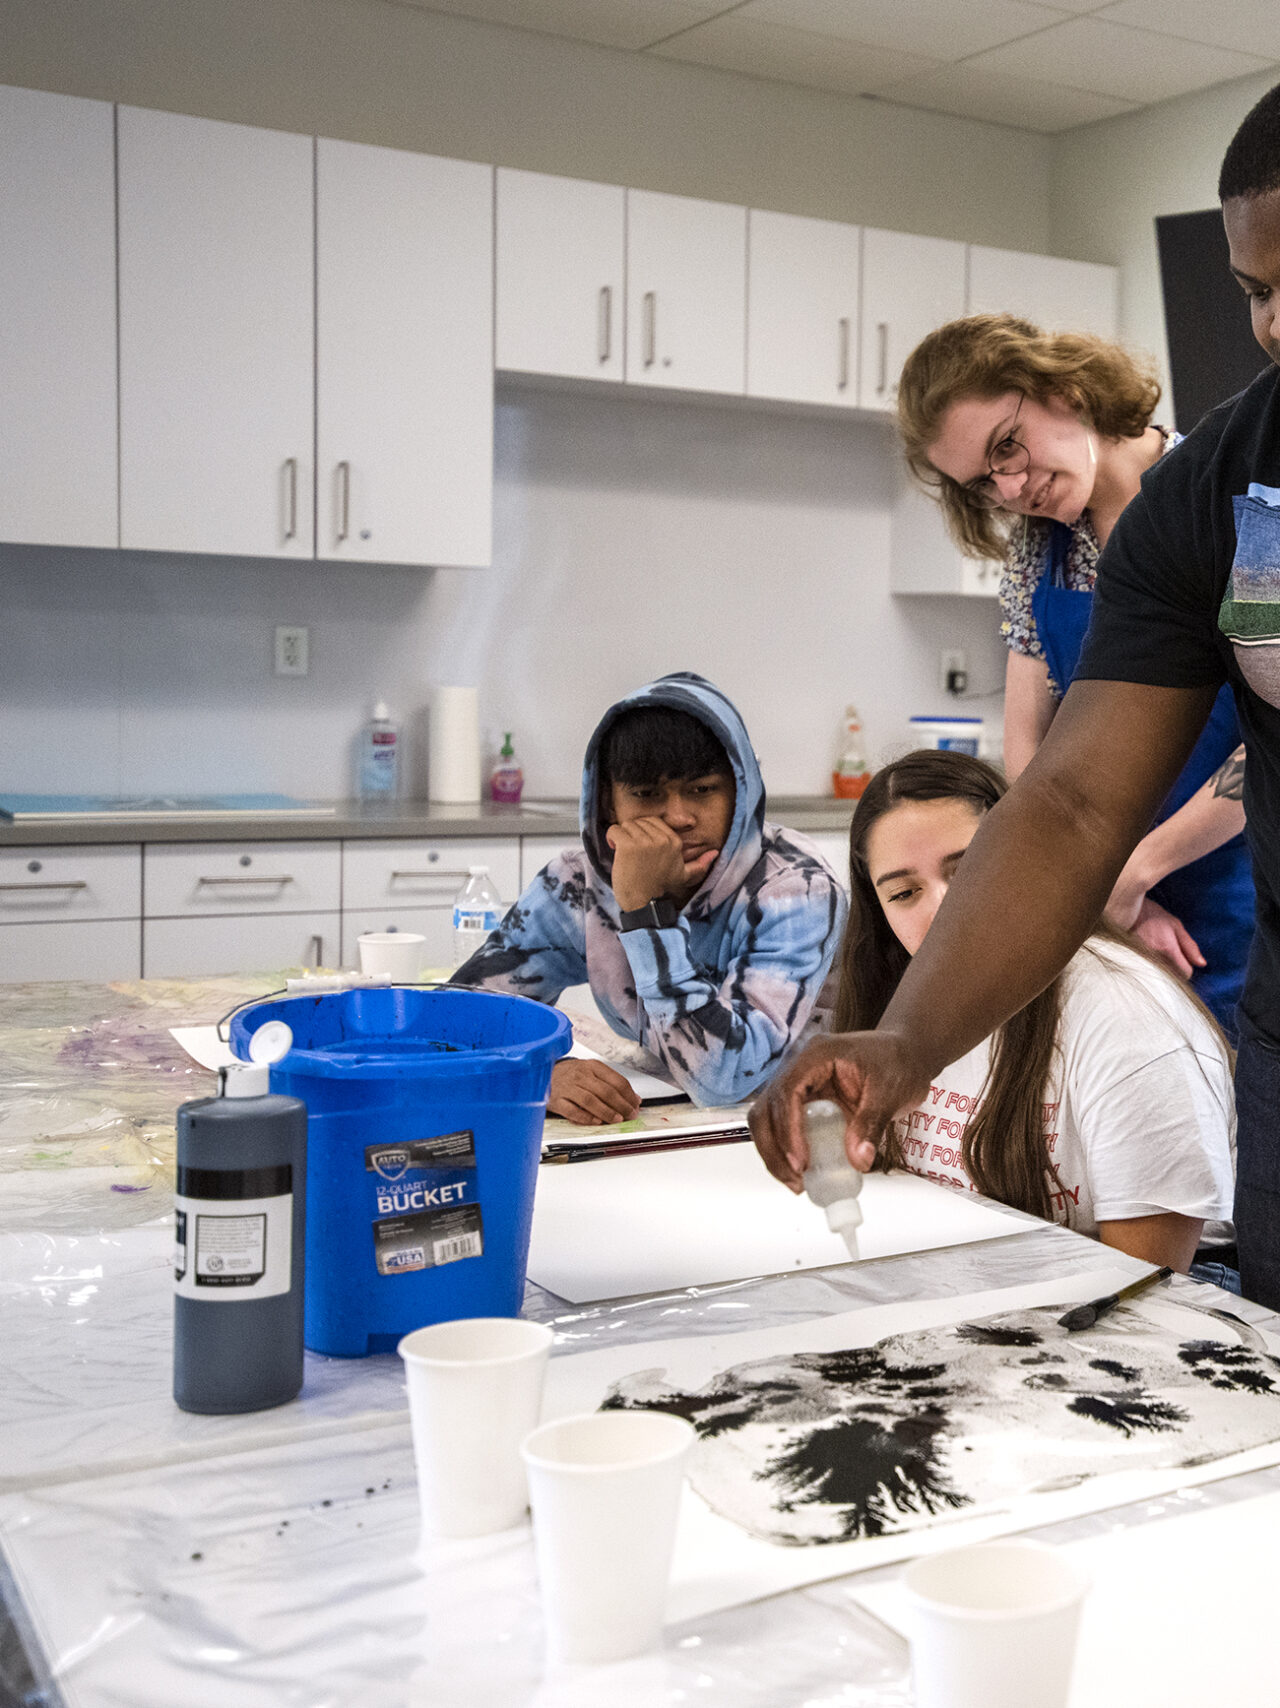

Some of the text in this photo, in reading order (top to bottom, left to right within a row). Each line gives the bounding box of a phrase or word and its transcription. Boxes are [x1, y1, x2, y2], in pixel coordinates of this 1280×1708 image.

[904, 1138, 929, 1158] ITY
[378, 1154, 406, 1165] AUTO
[376, 1180, 428, 1196] 12-QUART
[377, 1181, 467, 1213] BUCKET
[1050, 1185, 1080, 1211] TY
[397, 1251, 423, 1265] USA
